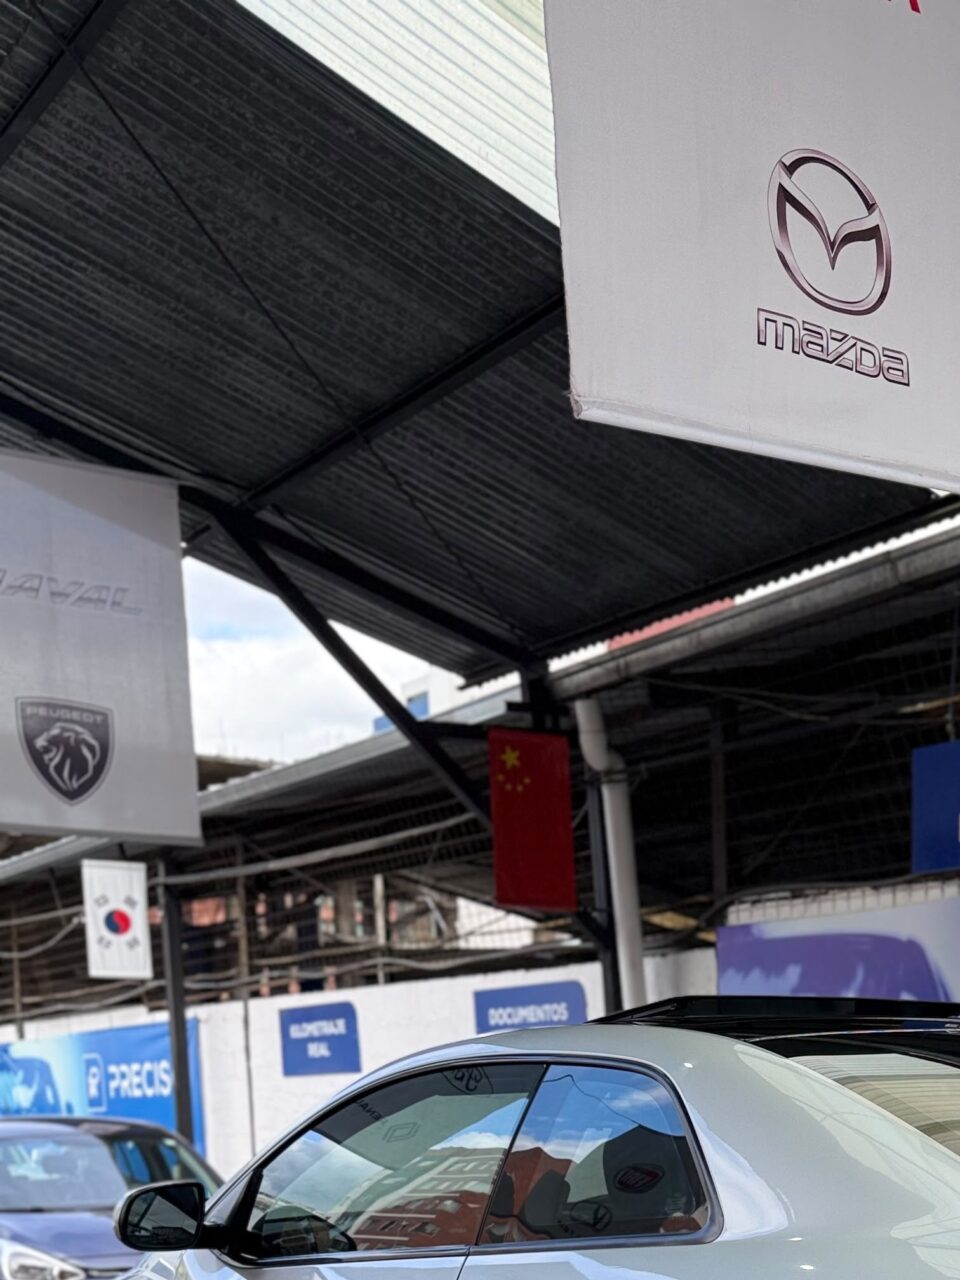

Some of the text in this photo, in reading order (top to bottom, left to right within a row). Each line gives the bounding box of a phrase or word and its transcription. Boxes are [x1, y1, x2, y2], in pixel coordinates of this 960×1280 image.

[757, 307, 910, 387] mazda
[25, 704, 104, 724] PEUGEOT
[488, 1002, 569, 1026] DOCUMENTOS
[307, 1042, 331, 1058] REAL
[107, 1061, 174, 1099] PRECIS
